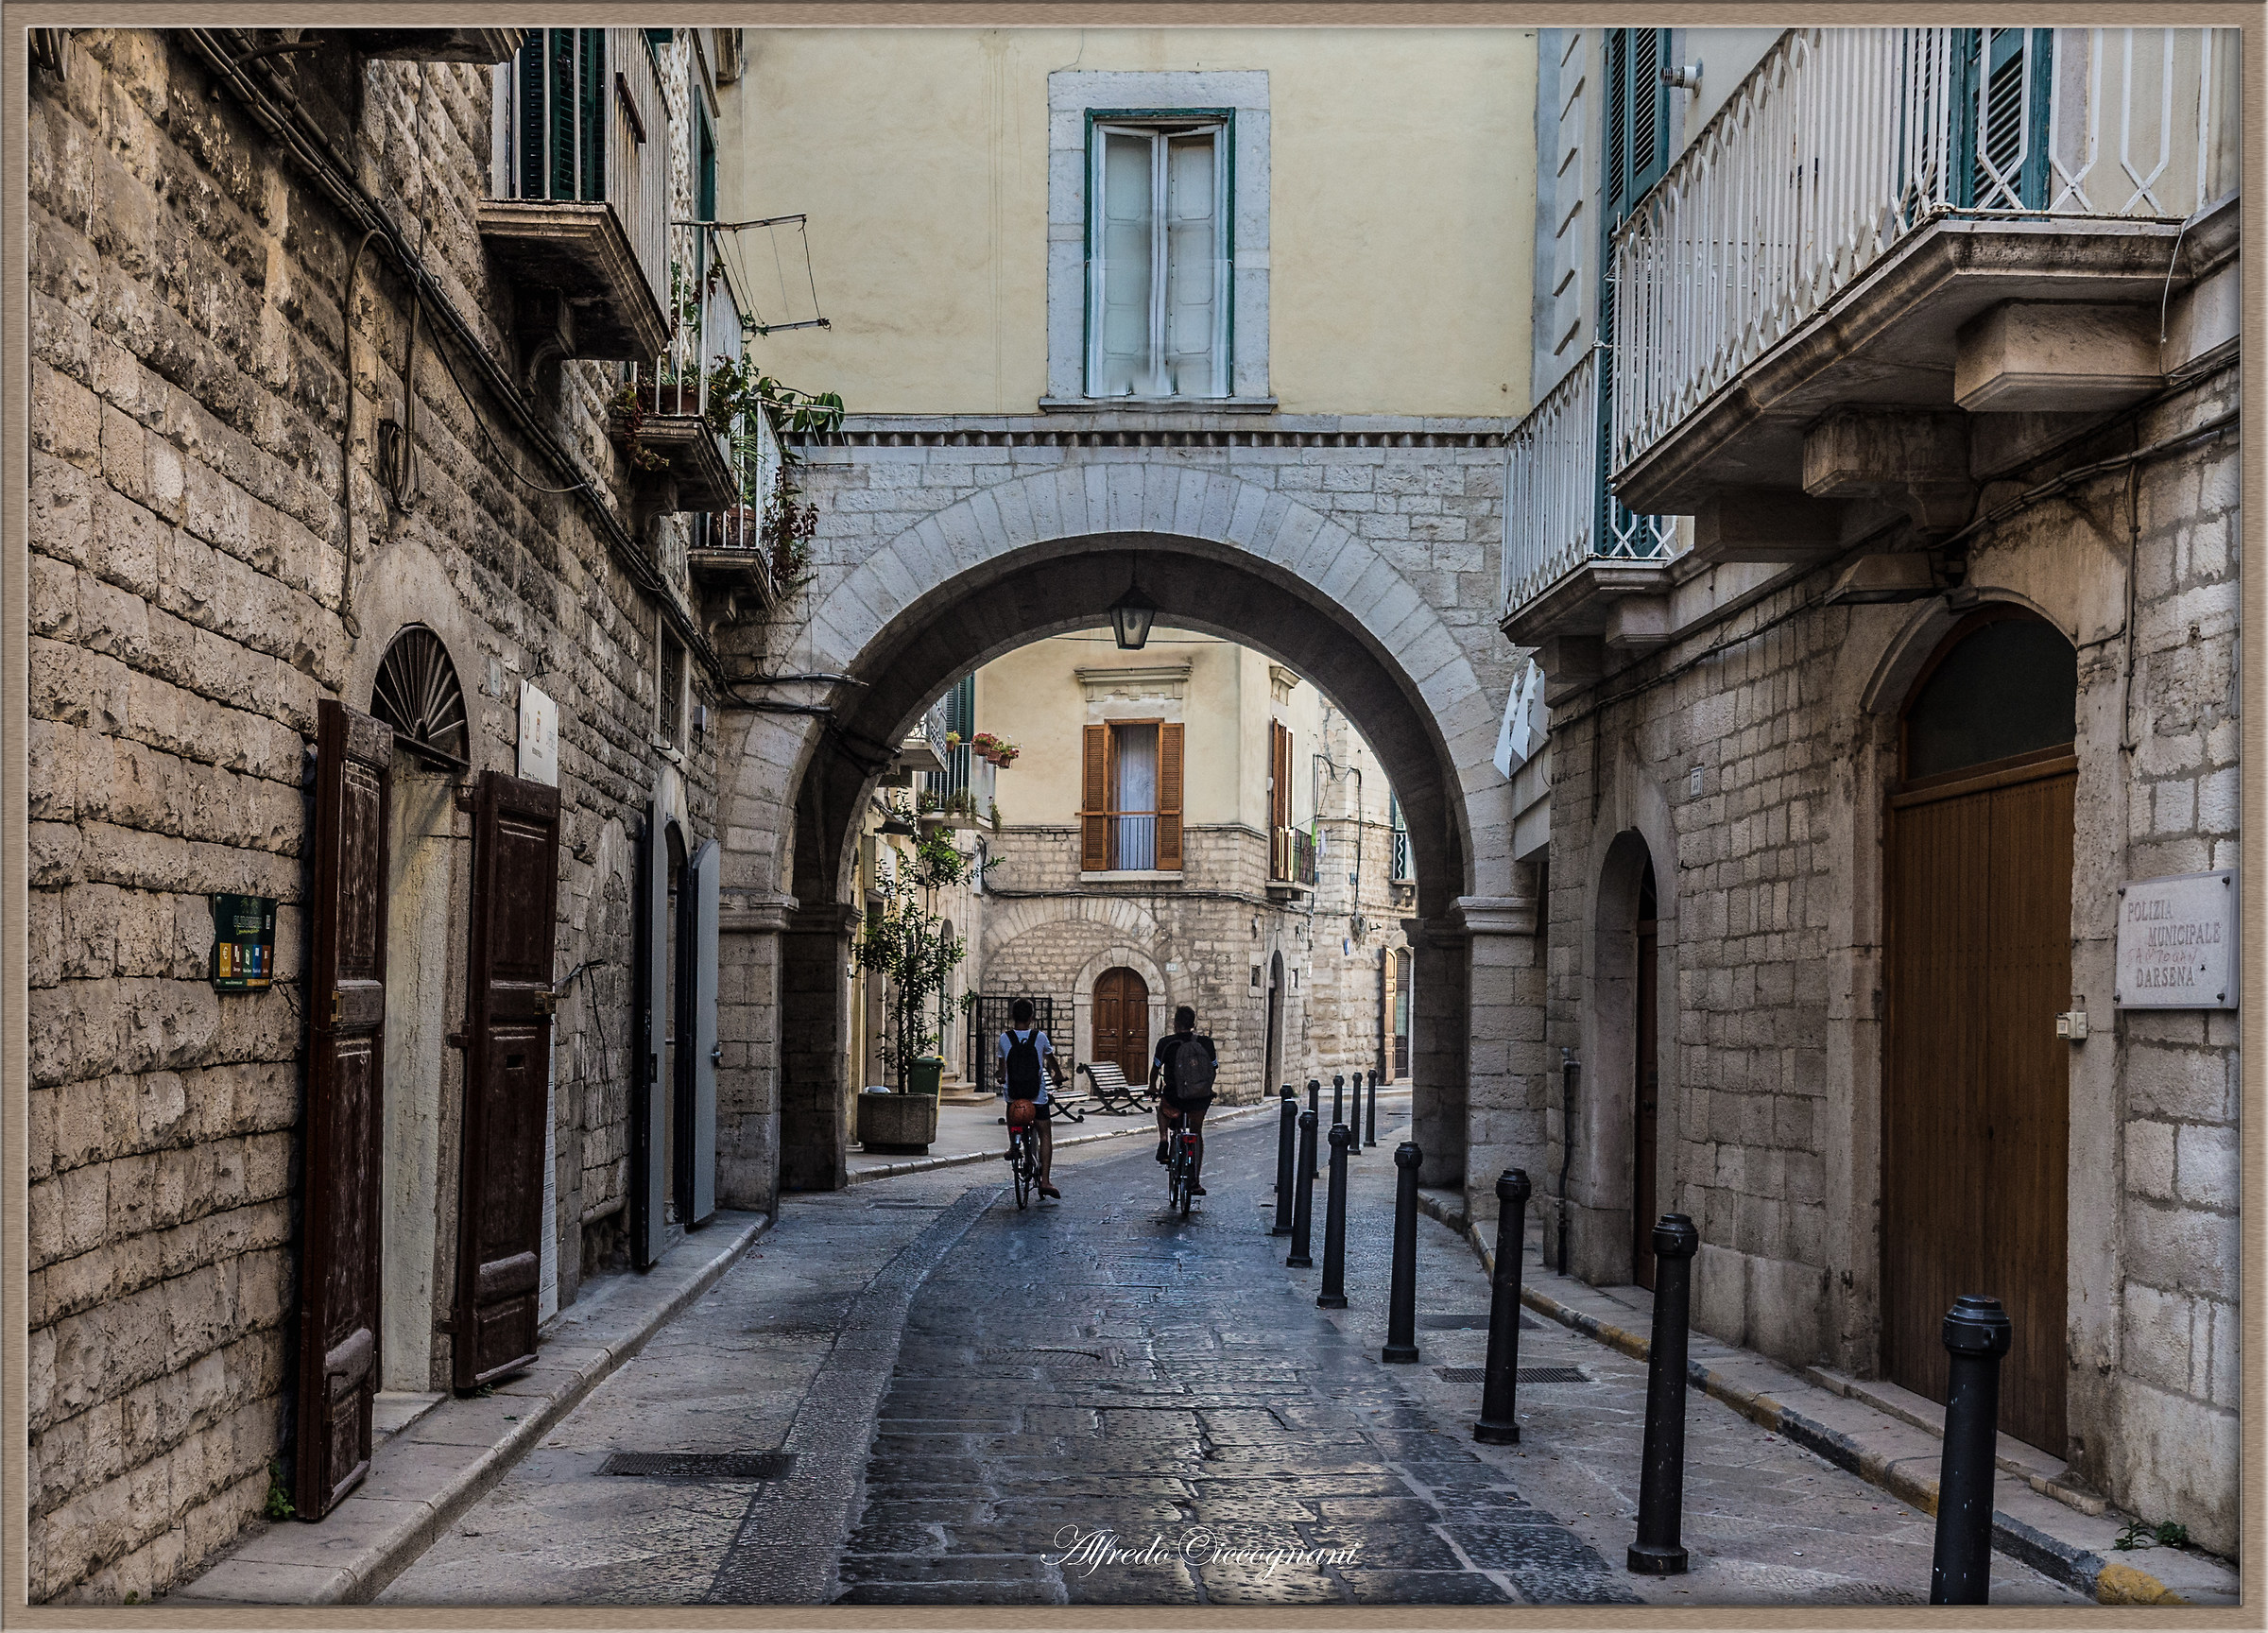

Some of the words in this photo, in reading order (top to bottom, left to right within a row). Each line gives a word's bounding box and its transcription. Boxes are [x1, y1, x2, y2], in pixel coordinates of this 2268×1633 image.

[2127, 899, 2174, 922] POLIZIA
[2148, 921, 2222, 947] MUNICIPALE
[2136, 966, 2195, 988] DARSENA
